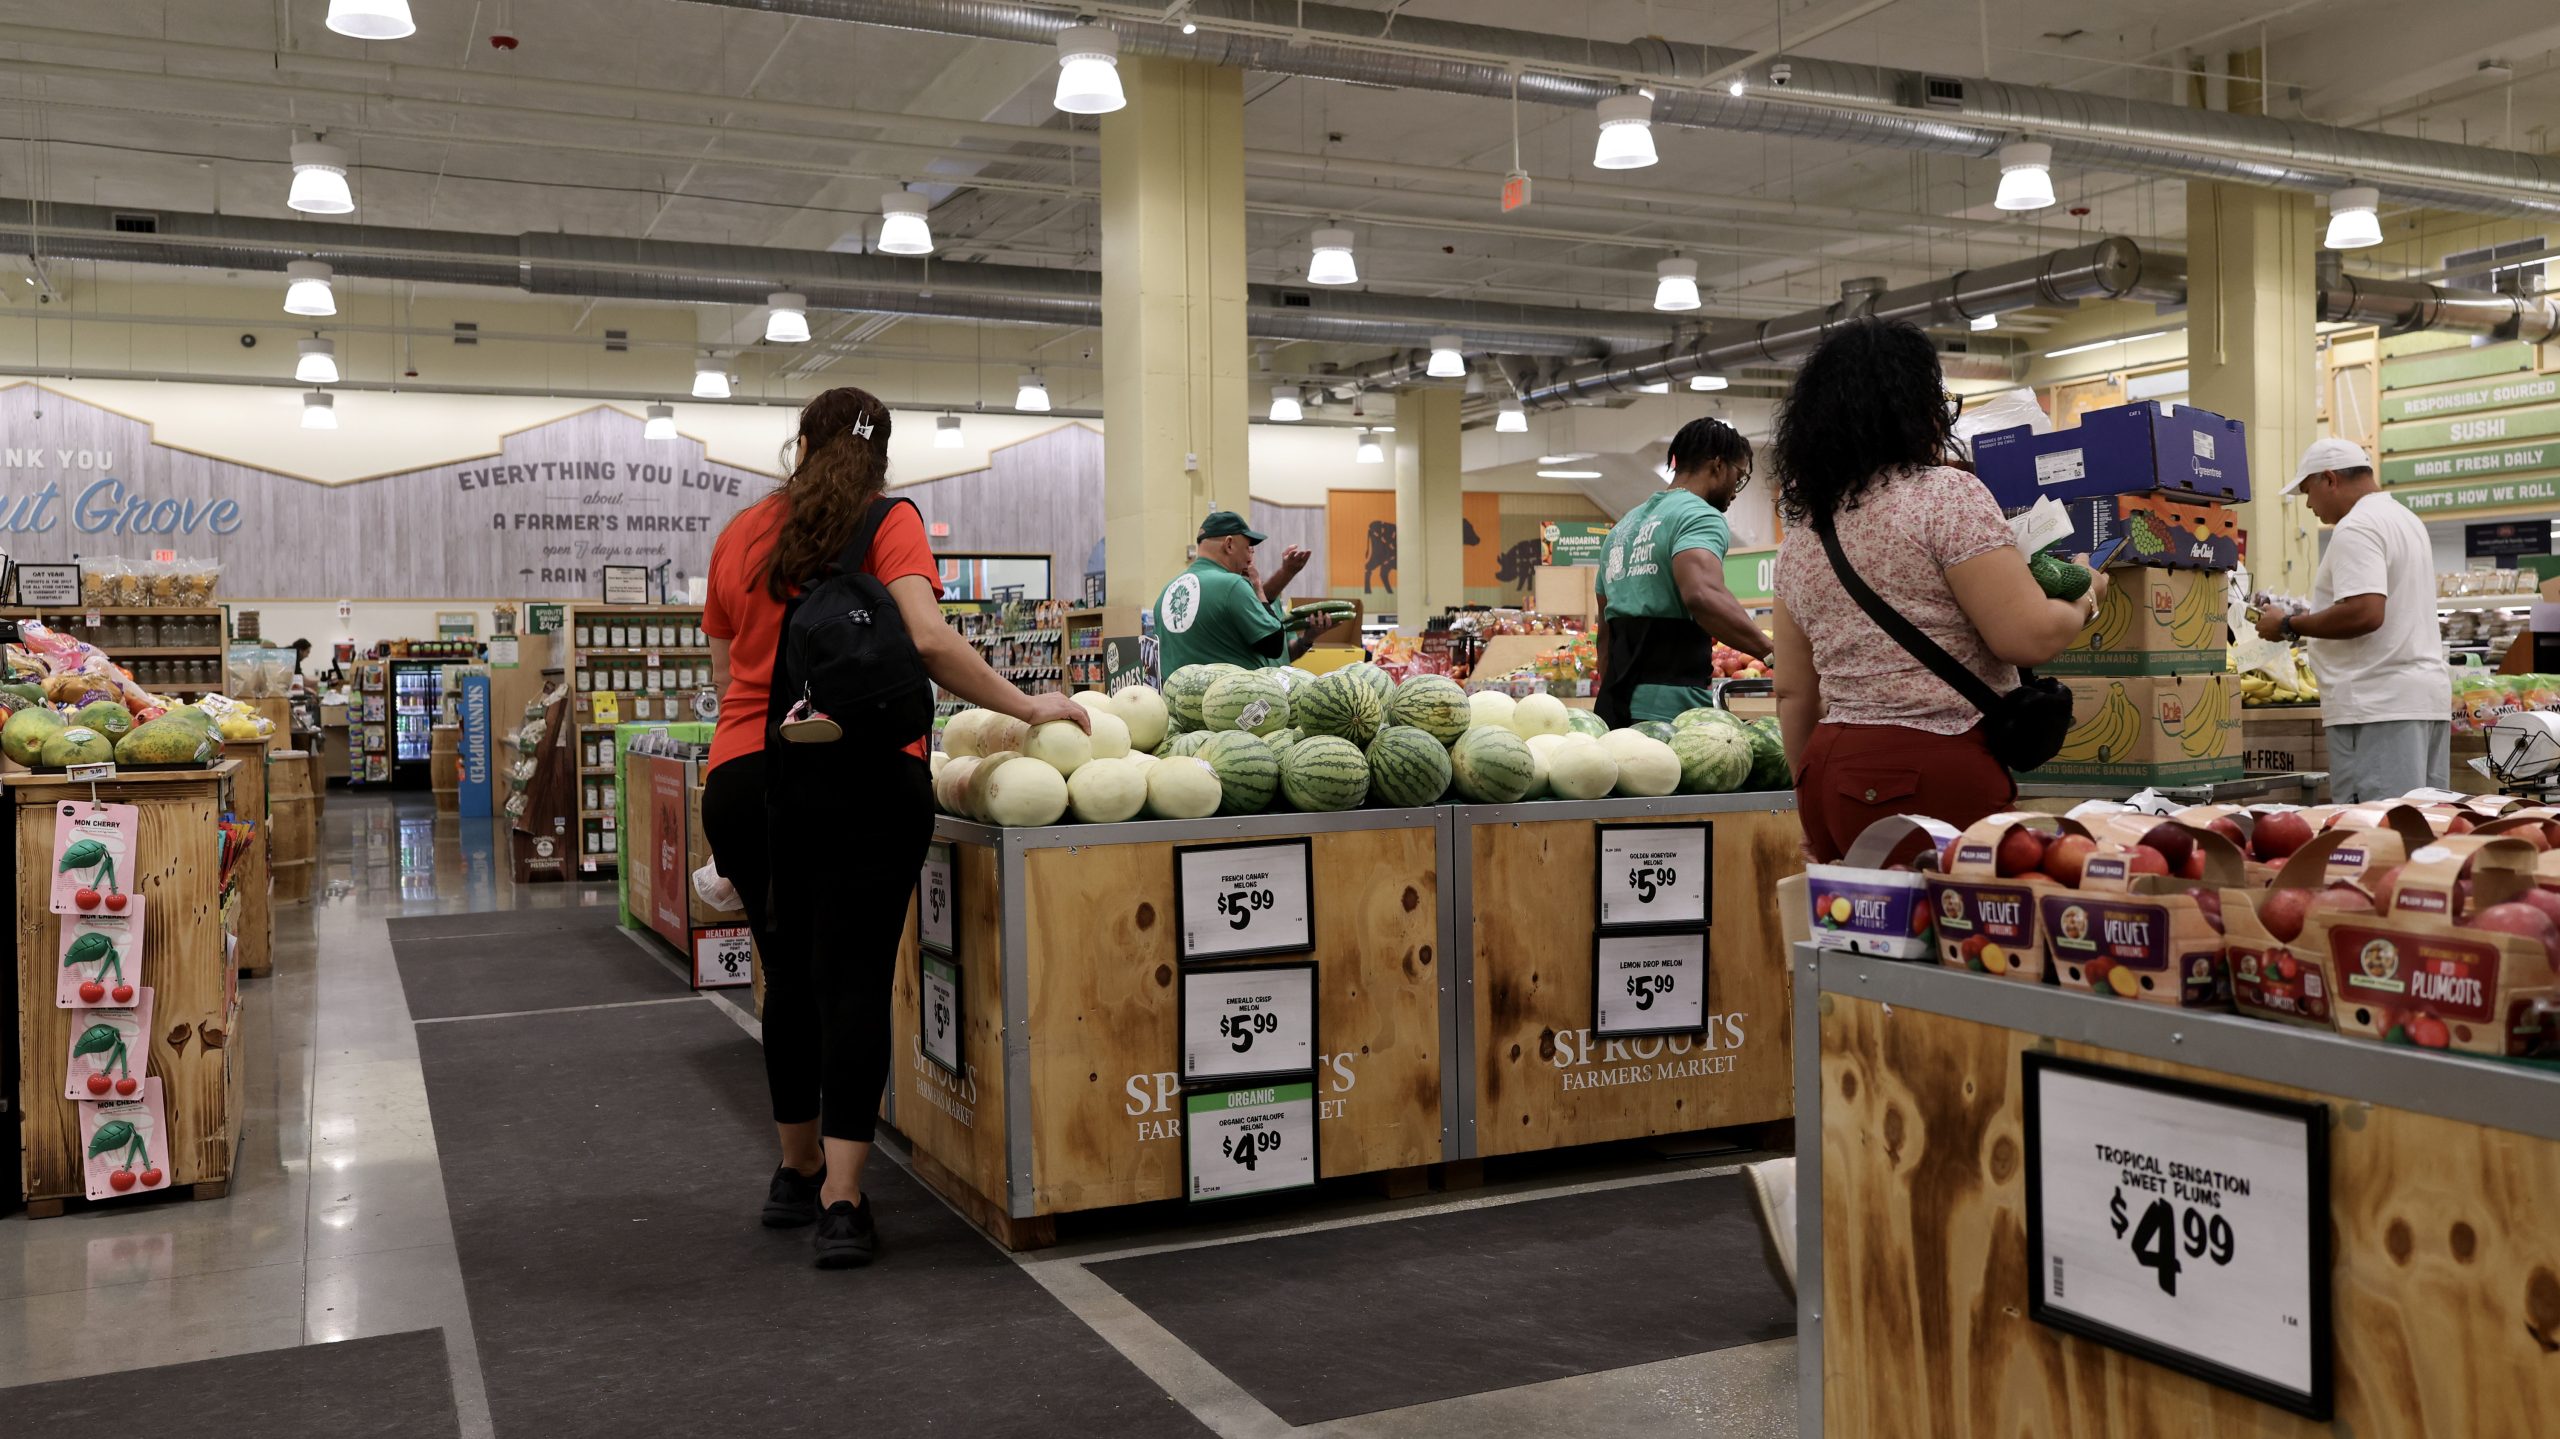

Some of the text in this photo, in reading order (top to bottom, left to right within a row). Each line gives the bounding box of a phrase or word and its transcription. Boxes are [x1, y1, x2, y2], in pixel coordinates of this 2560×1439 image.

[2404, 380, 2556, 414] RESPONSIBLY SOURCED
[2450, 418, 2506, 441] SUSHI
[57, 450, 113, 470] YOU
[2414, 450, 2544, 478] MADE FRESH DAILY
[458, 461, 742, 497] EVERYTHING YOU LOVE
[2199, 466, 2222, 478] greentree
[2407, 482, 2555, 509] THAT'S HOW WE ROLL
[72, 478, 242, 535] Grove
[493, 513, 711, 532] A FARMER'S MARKET
[1559, 536, 1600, 546] MANDARINS
[543, 544, 572, 559] open
[574, 541, 589, 559] 7
[591, 541, 621, 563] days
[624, 546, 632, 555] a
[541, 568, 587, 583] RAIN
[2156, 591, 2172, 609] Dole
[539, 622, 559, 631] SALE
[2053, 653, 2091, 664] ORGANIC
[2094, 653, 2138, 664] BANANAS
[2163, 701, 2181, 720] Dole
[468, 685, 485, 784] SKINNYDIPPED
[2061, 764, 2101, 775] ORGANIC
[2103, 765, 2148, 776] BANANAS
[93, 820, 120, 828] CHERRY
[1221, 872, 1269, 883] FRENCH CANARY
[1234, 880, 1257, 888] MELONS
[1855, 899, 1887, 920] VELVET
[1978, 900, 2020, 925] VELVET
[706, 929, 735, 938] HEALTHY
[2104, 919, 2150, 946] VELVET
[1620, 959, 1683, 969] LEMON DROP MELON
[2411, 969, 2482, 1008] PLUMCOTS
[1226, 996, 1272, 1005] EMERALD CRISP
[1239, 1003, 1259, 1011] MELON
[1562, 1055, 1737, 1091] FARMERS MARKET
[98, 1100, 114, 1109] MON
[1227, 1088, 1275, 1108] ORGANIC
[1219, 1112, 1284, 1126] ORGANIC CANTALOUPE
[1240, 1123, 1264, 1132] MELONS
[2095, 1144, 2251, 1197] TROPICAL SENSATION
[2121, 1170, 2221, 1209] SWEET PLUMS
